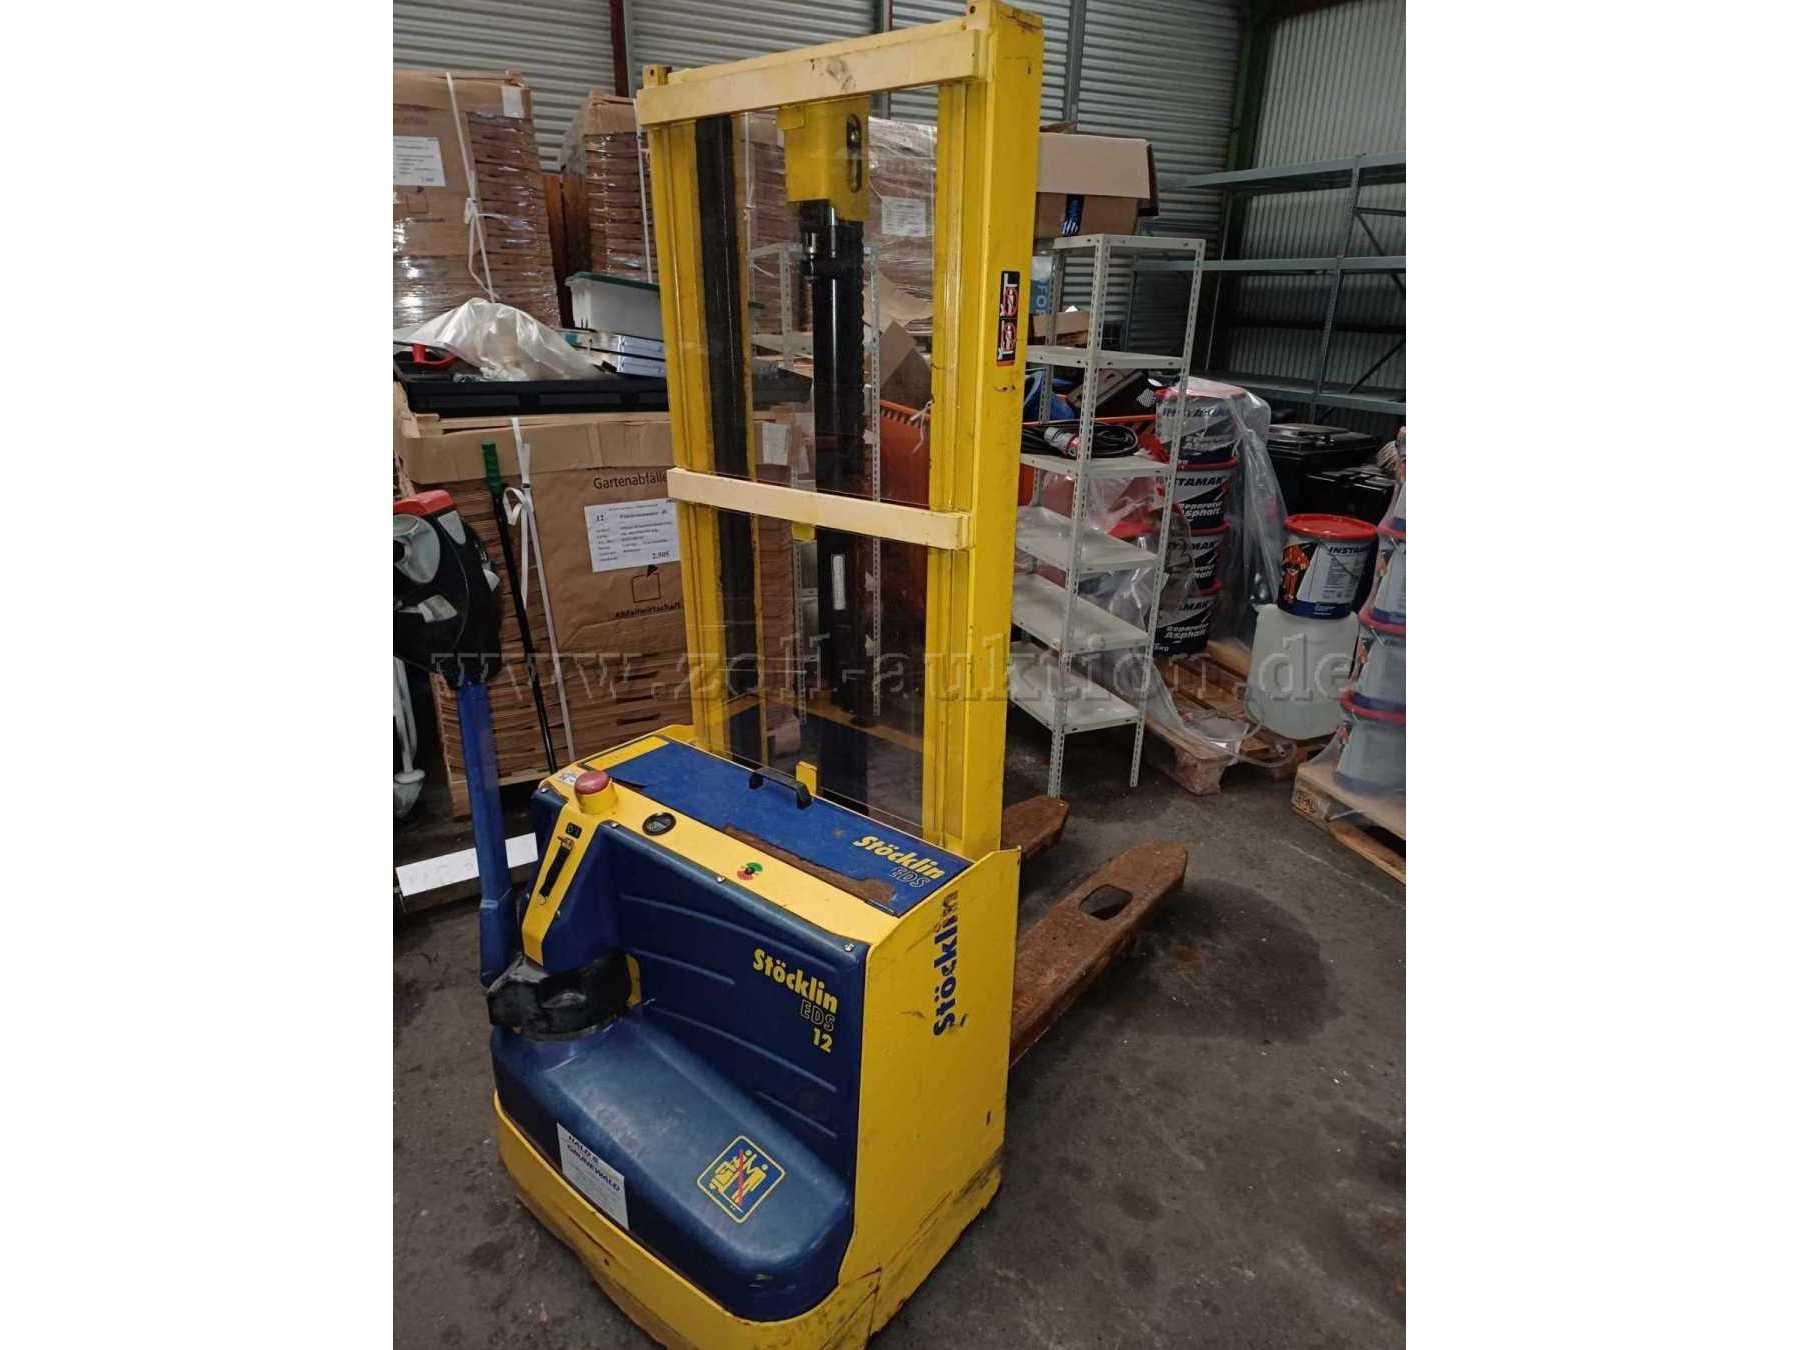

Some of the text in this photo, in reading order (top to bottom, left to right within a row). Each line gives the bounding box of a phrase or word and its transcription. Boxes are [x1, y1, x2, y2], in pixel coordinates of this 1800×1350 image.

[853, 835, 945, 879] Stöcklin
[889, 866, 929, 888] EDS
[753, 948, 838, 1014] Stöcklin
[933, 890, 959, 1036] Stöcklin
[801, 999, 836, 1032] EDS
[813, 1027, 833, 1053] 12
